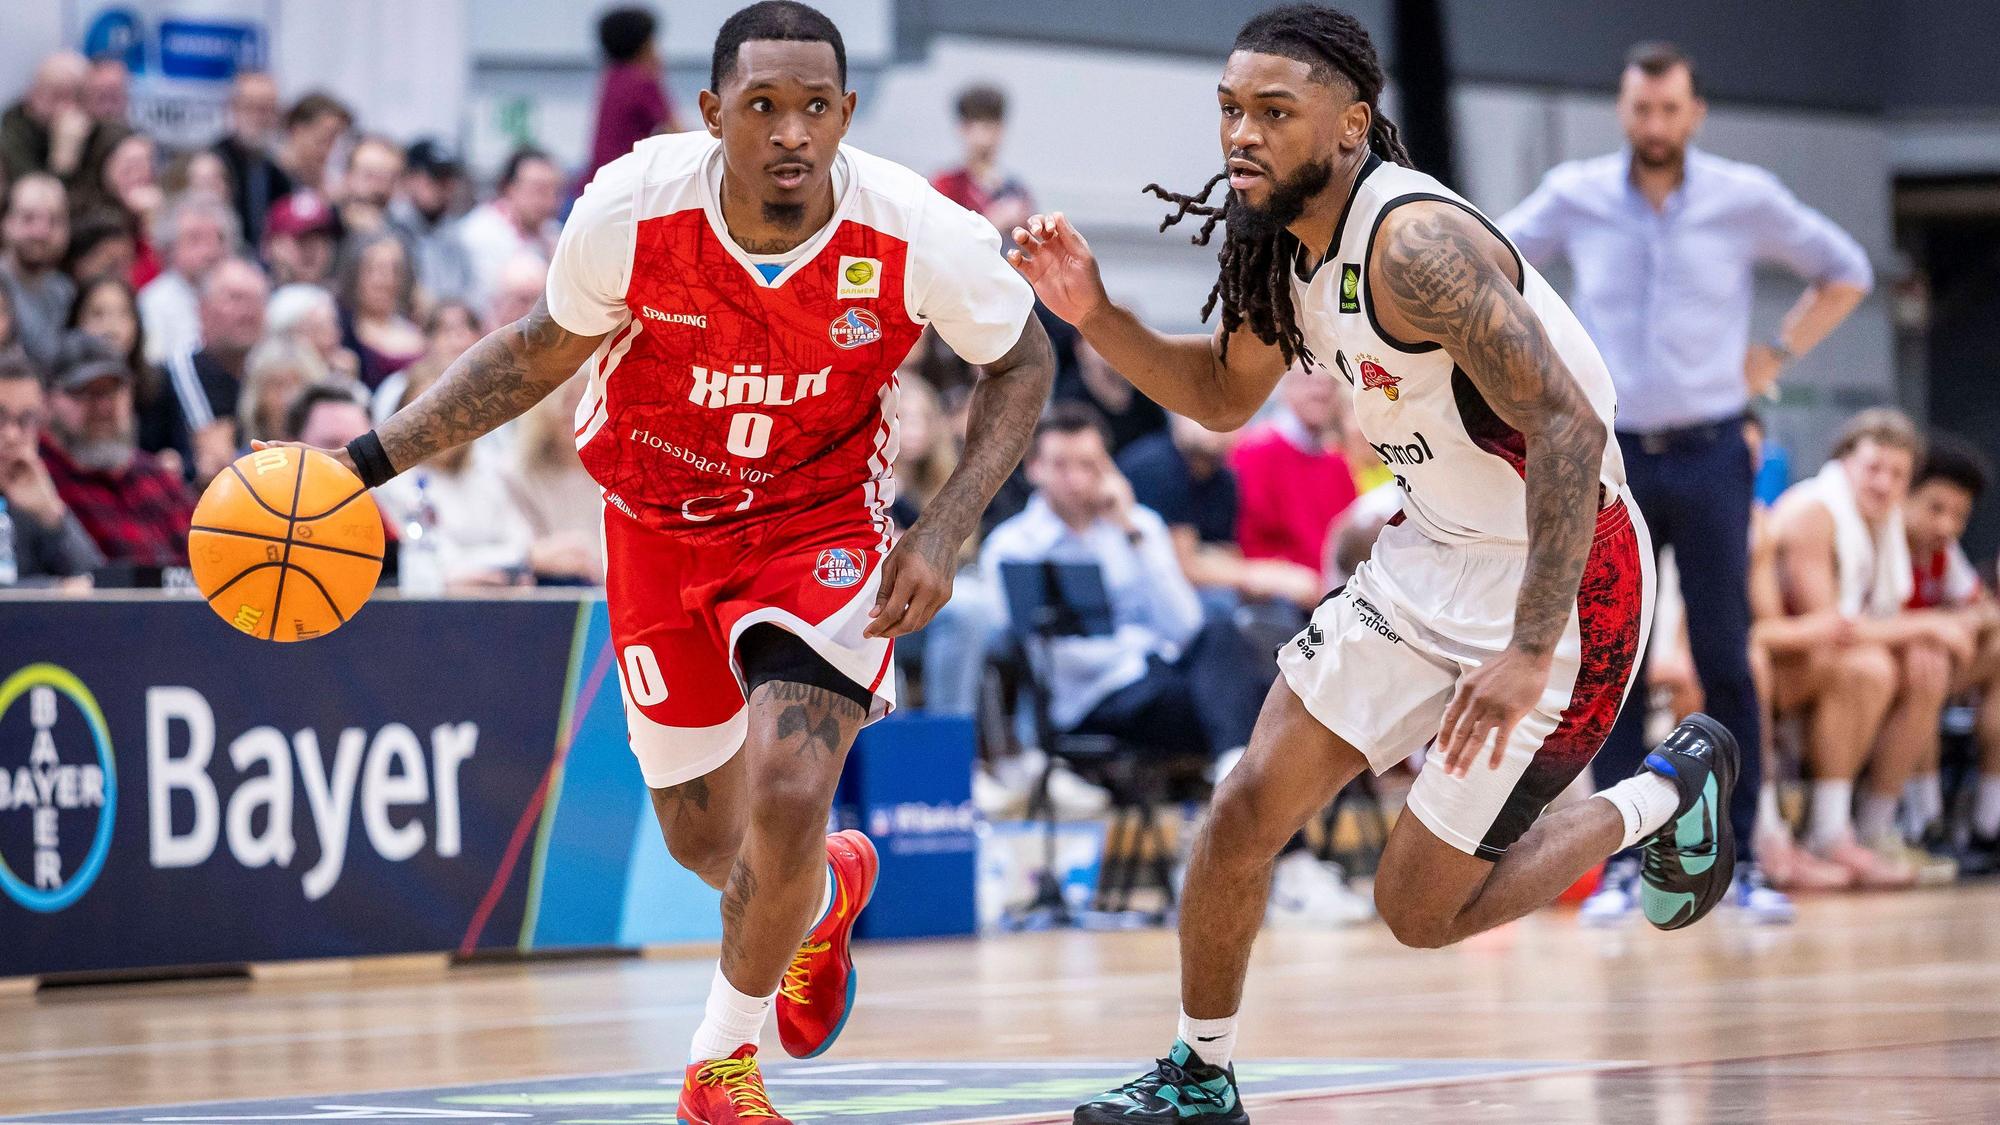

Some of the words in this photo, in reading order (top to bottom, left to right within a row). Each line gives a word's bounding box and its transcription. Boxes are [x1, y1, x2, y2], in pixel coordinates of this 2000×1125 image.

[642, 305, 707, 329] SPALDING
[726, 412, 774, 459] 0
[1358, 612, 1403, 645] othaer
[624, 644, 669, 707] 0
[29, 686, 62, 890] BAYER
[146, 686, 479, 901] Bayer
